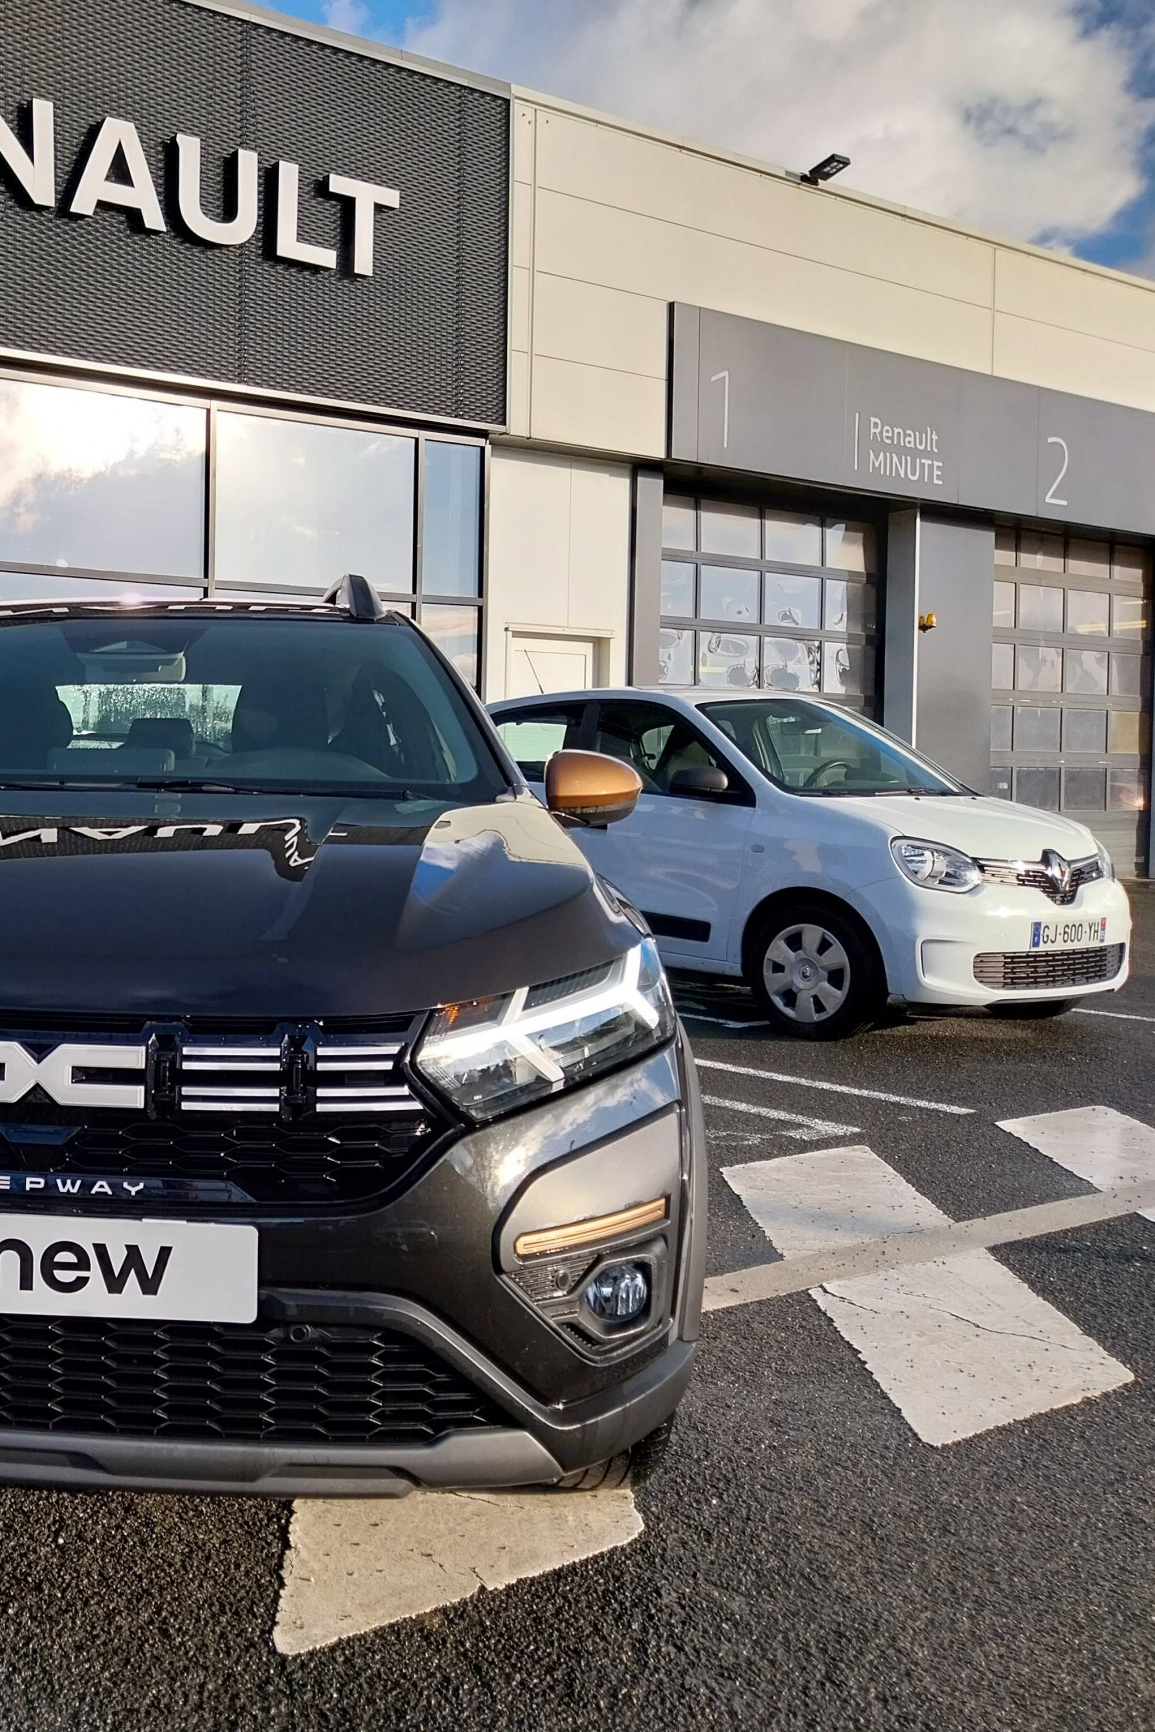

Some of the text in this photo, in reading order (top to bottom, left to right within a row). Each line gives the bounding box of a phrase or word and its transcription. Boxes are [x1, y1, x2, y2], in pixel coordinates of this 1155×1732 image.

[710, 369, 730, 448] 1
[869, 416, 939, 453] Renault
[868, 449, 944, 485] MINUTE
[1045, 436, 1069, 506] 2
[1042, 921, 1100, 944] GJ-600-YH
